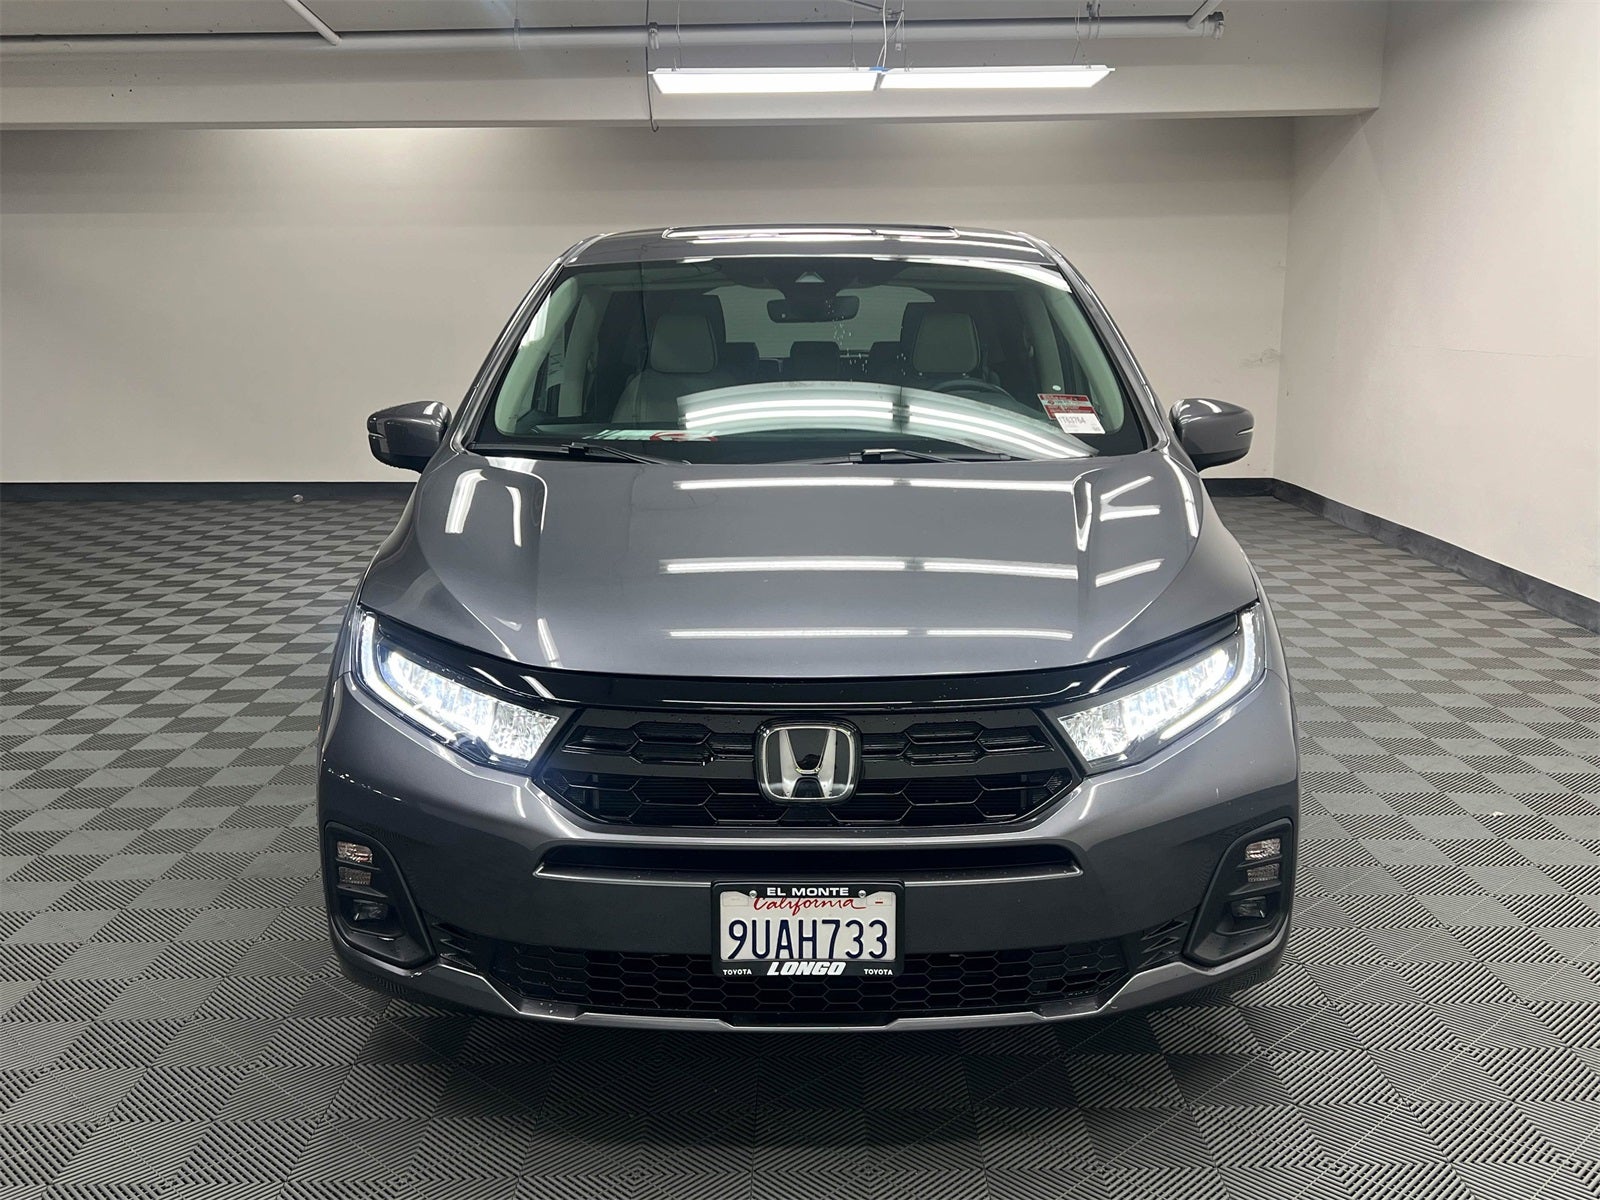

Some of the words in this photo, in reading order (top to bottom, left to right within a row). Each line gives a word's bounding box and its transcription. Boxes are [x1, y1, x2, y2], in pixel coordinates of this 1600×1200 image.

[766, 887, 782, 896] EL
[791, 887, 849, 896] MONTE
[753, 896, 867, 916] California
[727, 919, 888, 960] 9UAH733
[722, 968, 752, 976] TOYOTA
[766, 961, 847, 976] LONGO
[863, 968, 893, 976] TOYOTA
